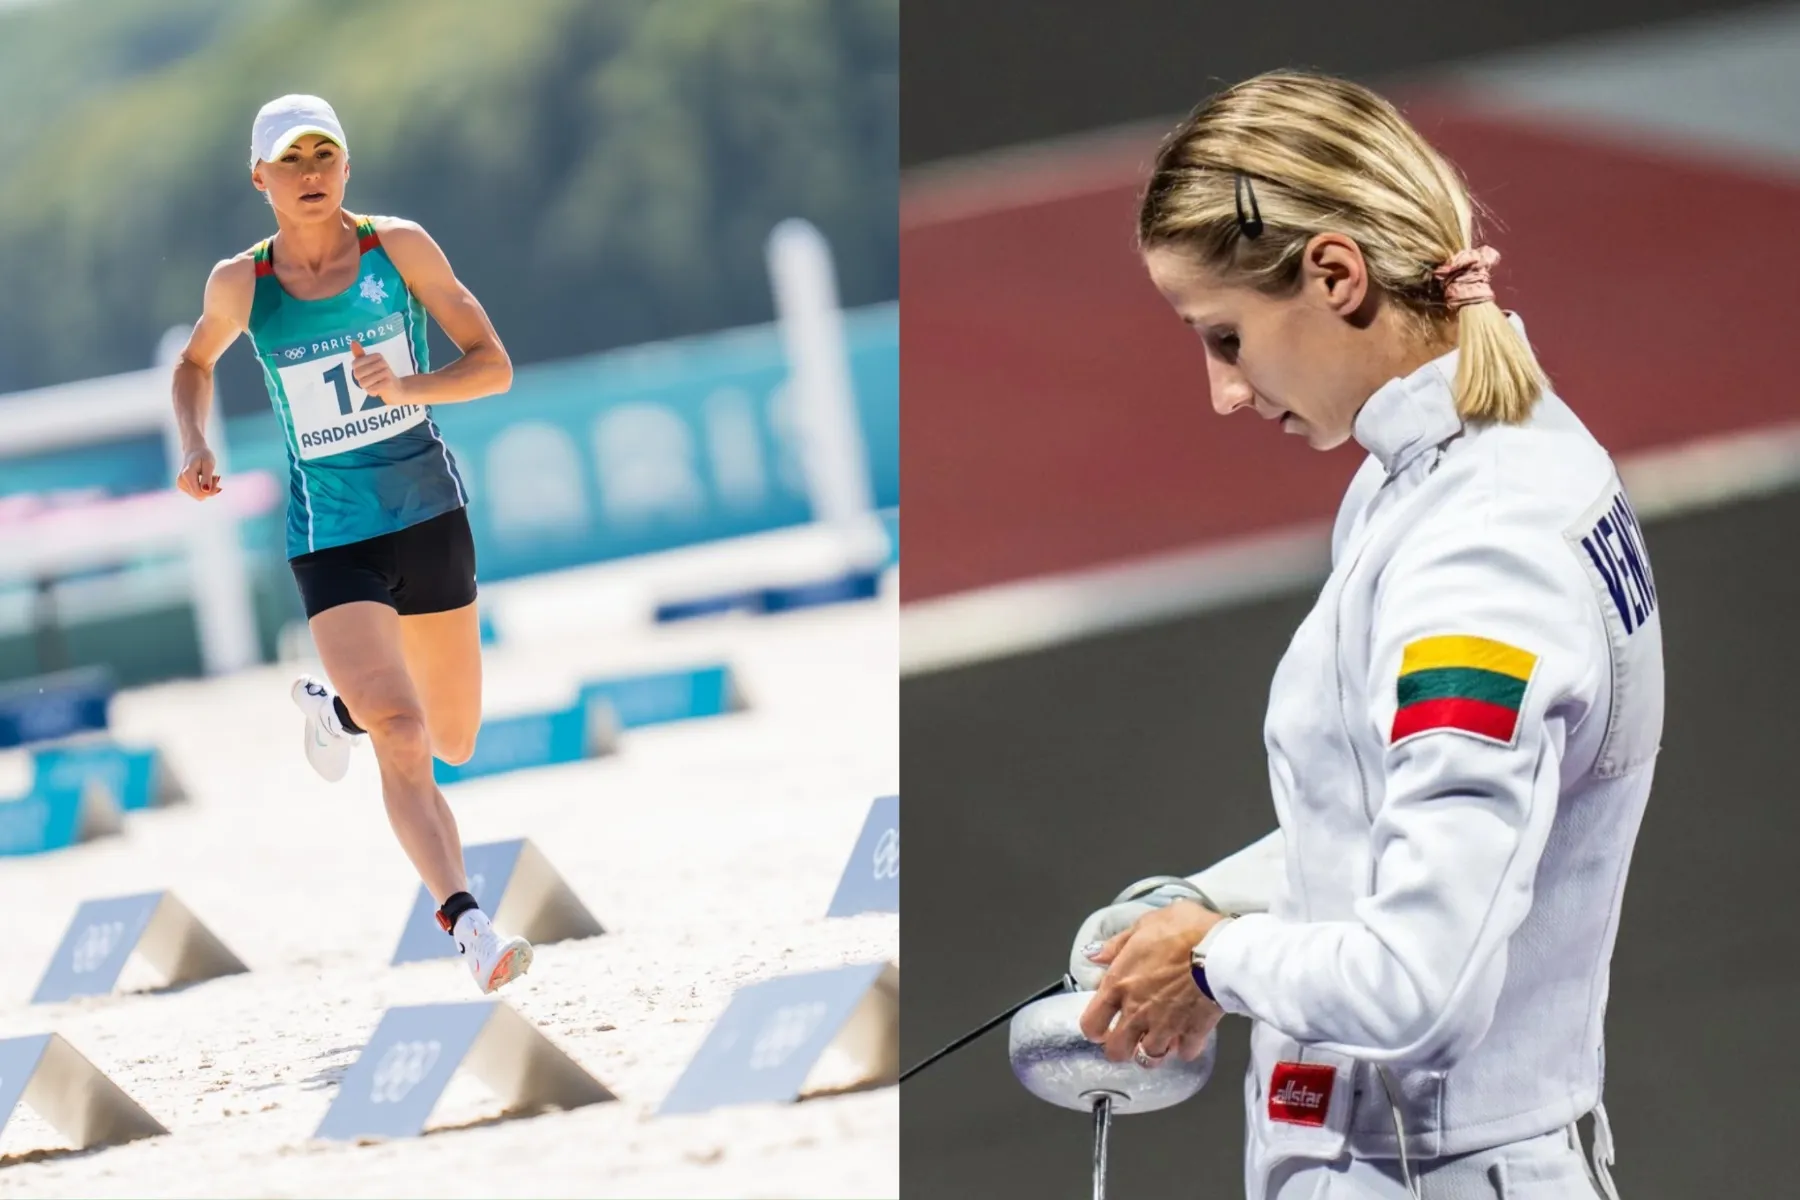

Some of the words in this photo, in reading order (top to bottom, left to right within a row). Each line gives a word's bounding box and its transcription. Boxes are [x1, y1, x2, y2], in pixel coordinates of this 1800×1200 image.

[312, 335, 352, 354] PARIS
[357, 324, 394, 342] 2024
[1273, 1080, 1323, 1108] allstar
